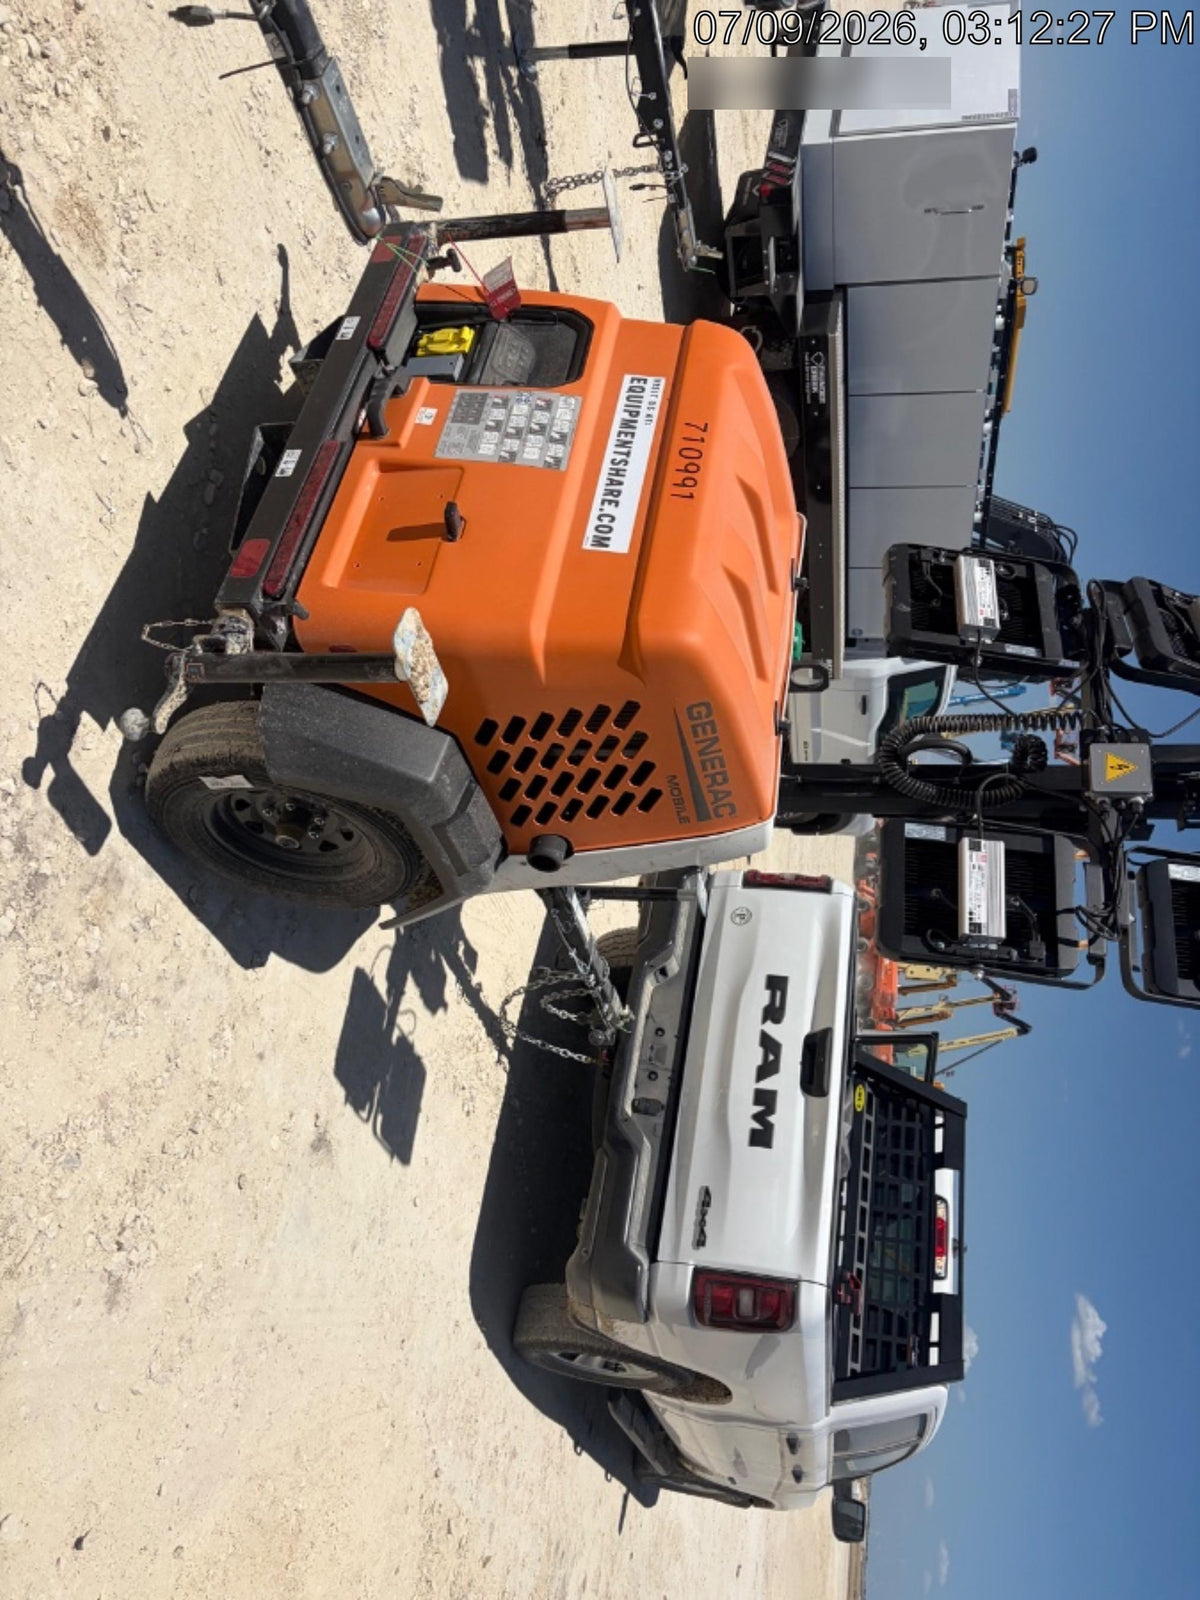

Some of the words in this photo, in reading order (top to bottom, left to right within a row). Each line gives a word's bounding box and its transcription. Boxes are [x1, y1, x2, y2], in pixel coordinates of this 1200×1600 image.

[590, 376, 648, 548] EQUIPMENTSHARE.COM
[670, 422, 708, 499] 710991
[666, 774, 690, 824] MOBILE
[686, 702, 736, 818] GENERAC
[748, 974, 789, 1149] RAM
[695, 1185, 712, 1248] 4x4
